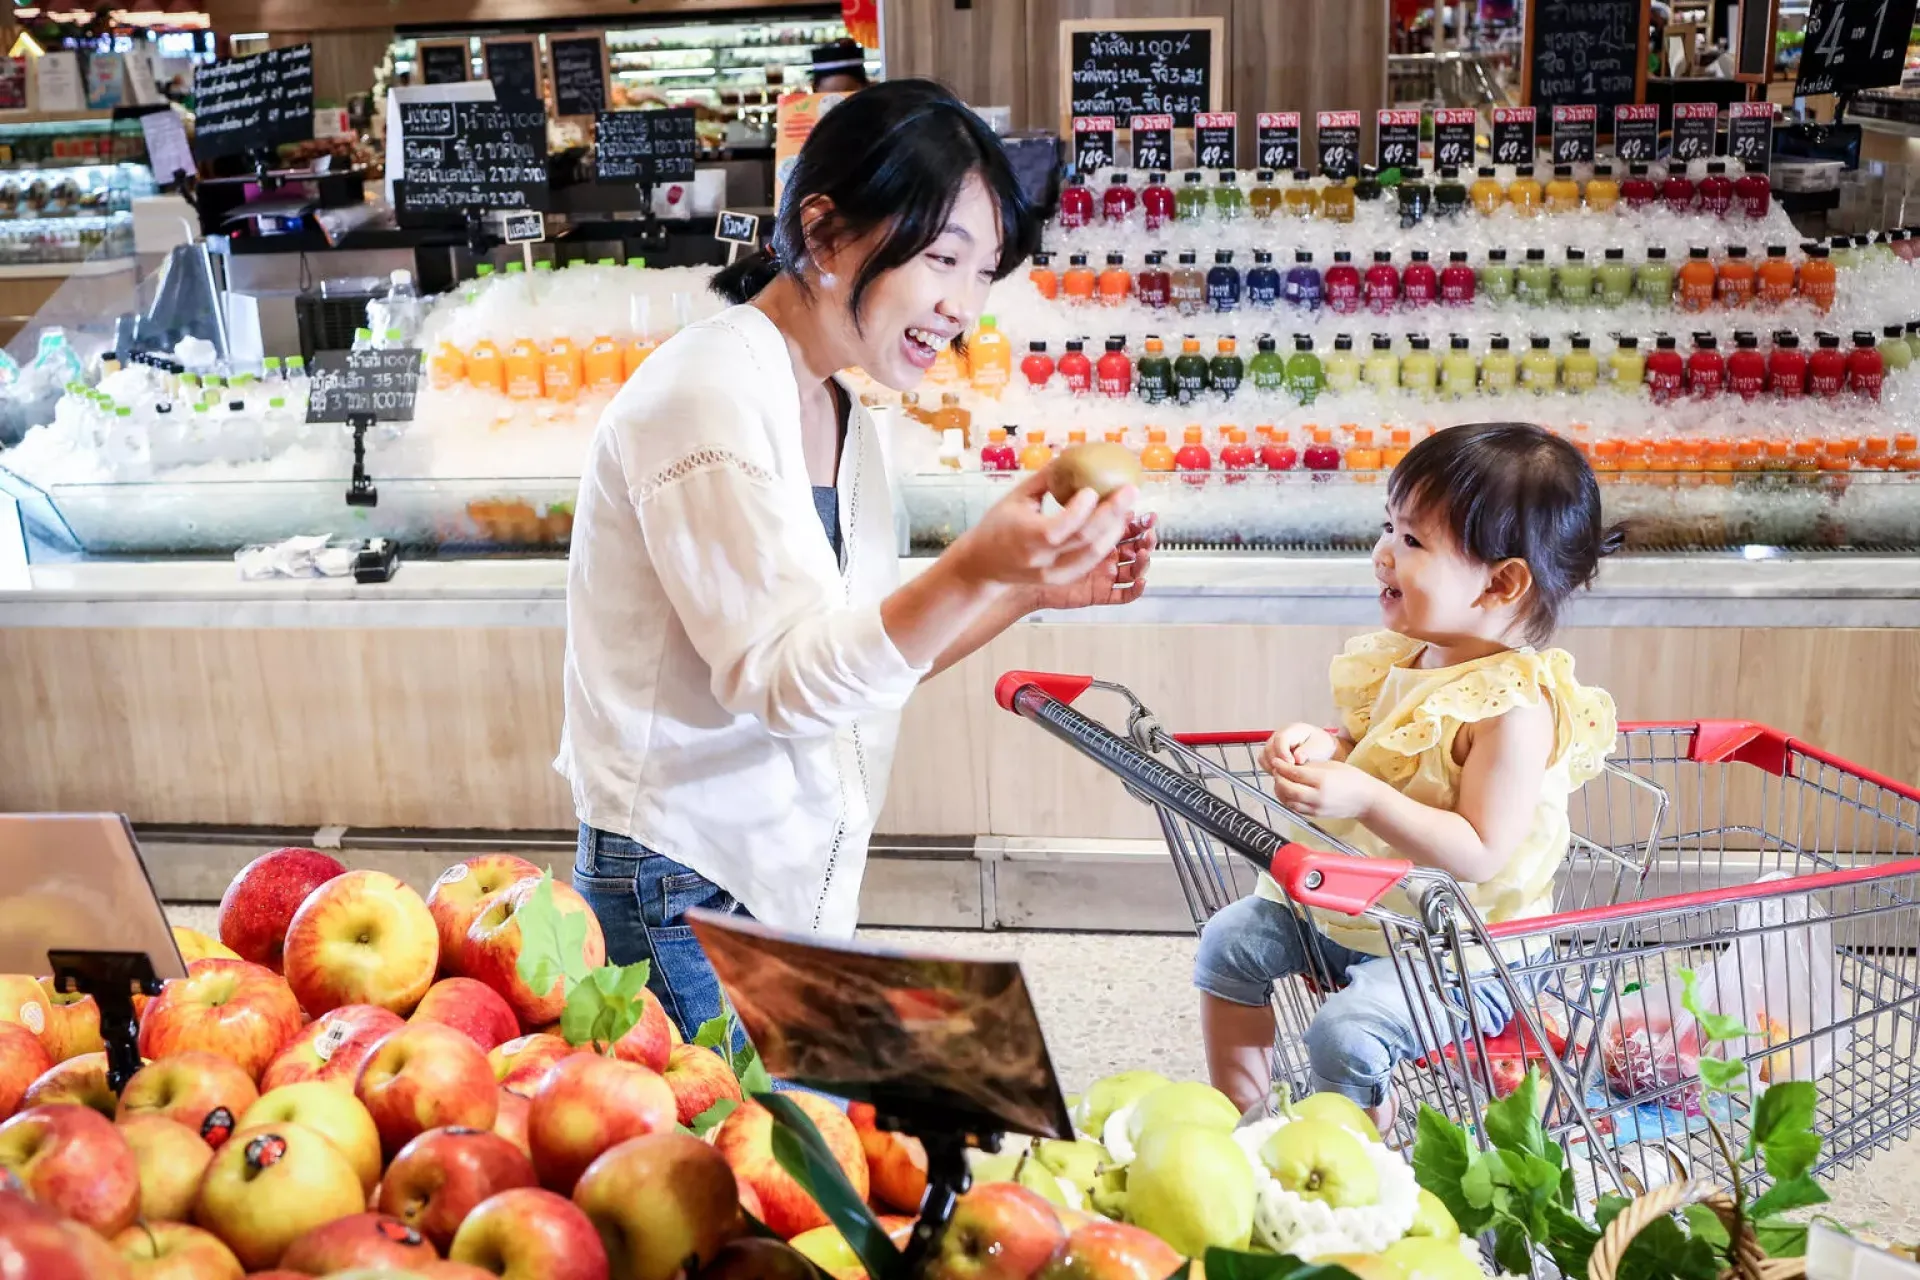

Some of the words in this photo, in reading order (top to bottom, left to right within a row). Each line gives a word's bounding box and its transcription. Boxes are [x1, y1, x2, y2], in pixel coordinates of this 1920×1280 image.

[1814, 2, 1845, 68] 4
[1581, 72, 1596, 95] 1
[1163, 94, 1173, 113] 6
